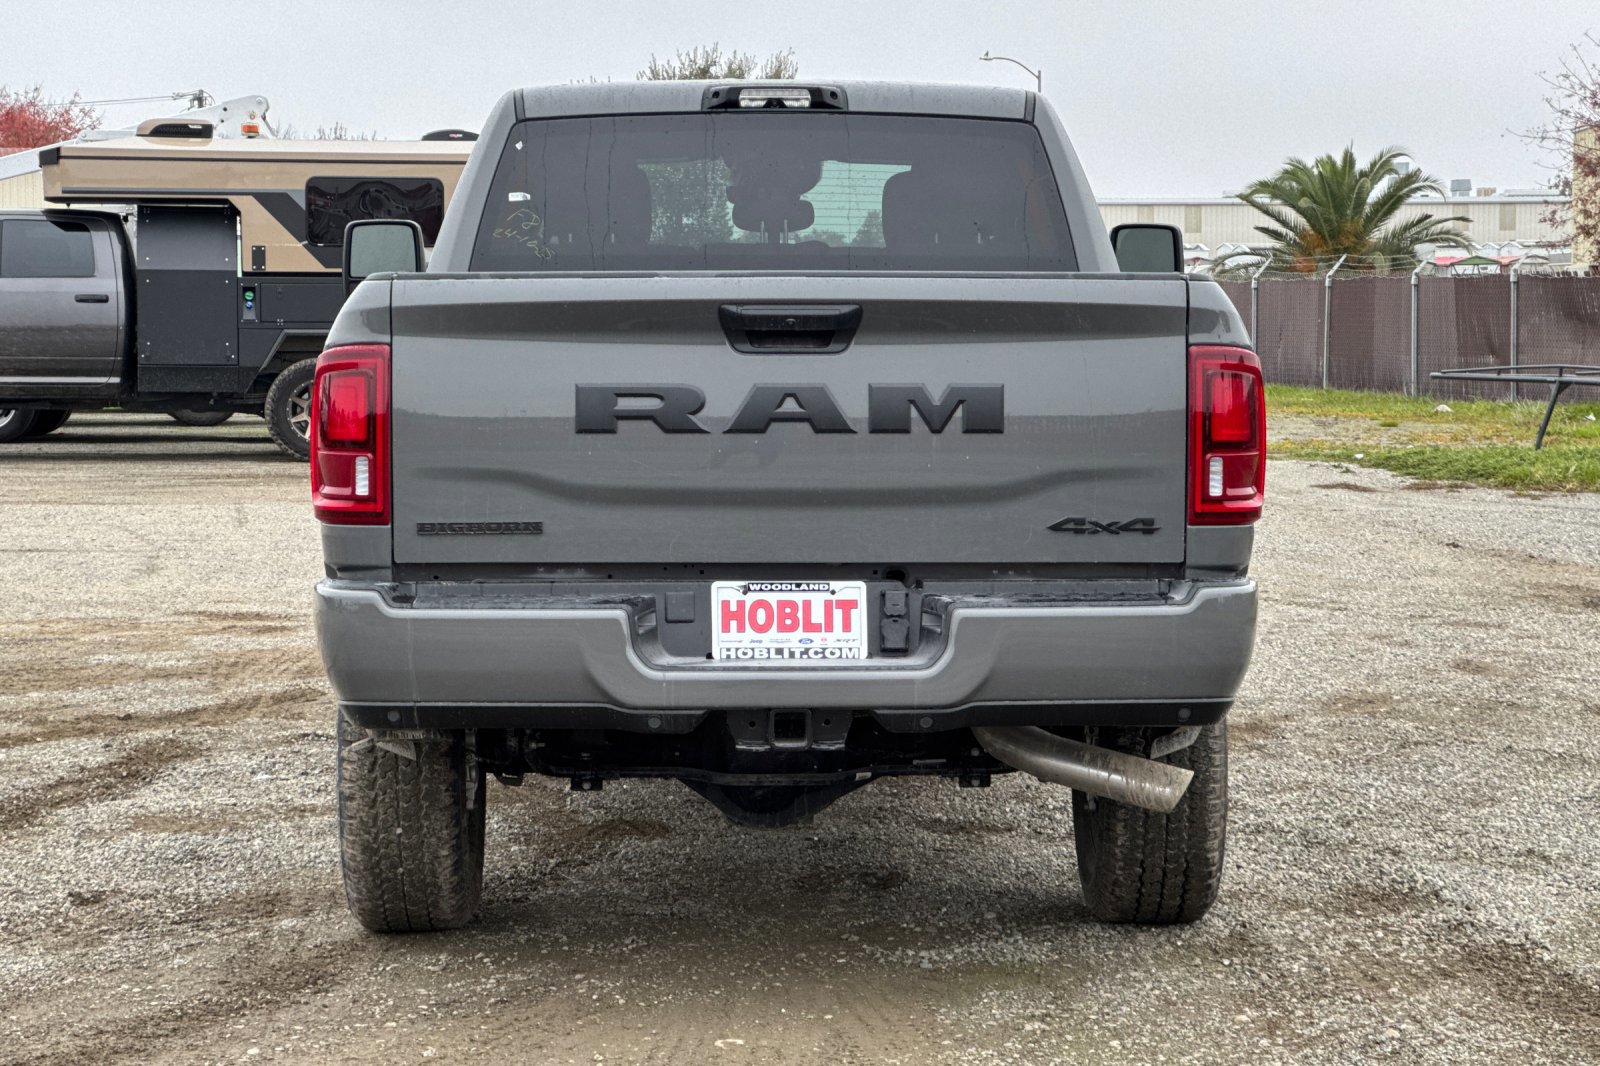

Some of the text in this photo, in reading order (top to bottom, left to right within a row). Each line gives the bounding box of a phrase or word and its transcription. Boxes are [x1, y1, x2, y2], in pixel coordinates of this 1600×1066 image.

[575, 383, 1005, 434] RAM
[748, 583, 829, 591] WOODLAND
[721, 599, 858, 634] HOBLIT
[720, 647, 859, 659] HOBLIT.COM
